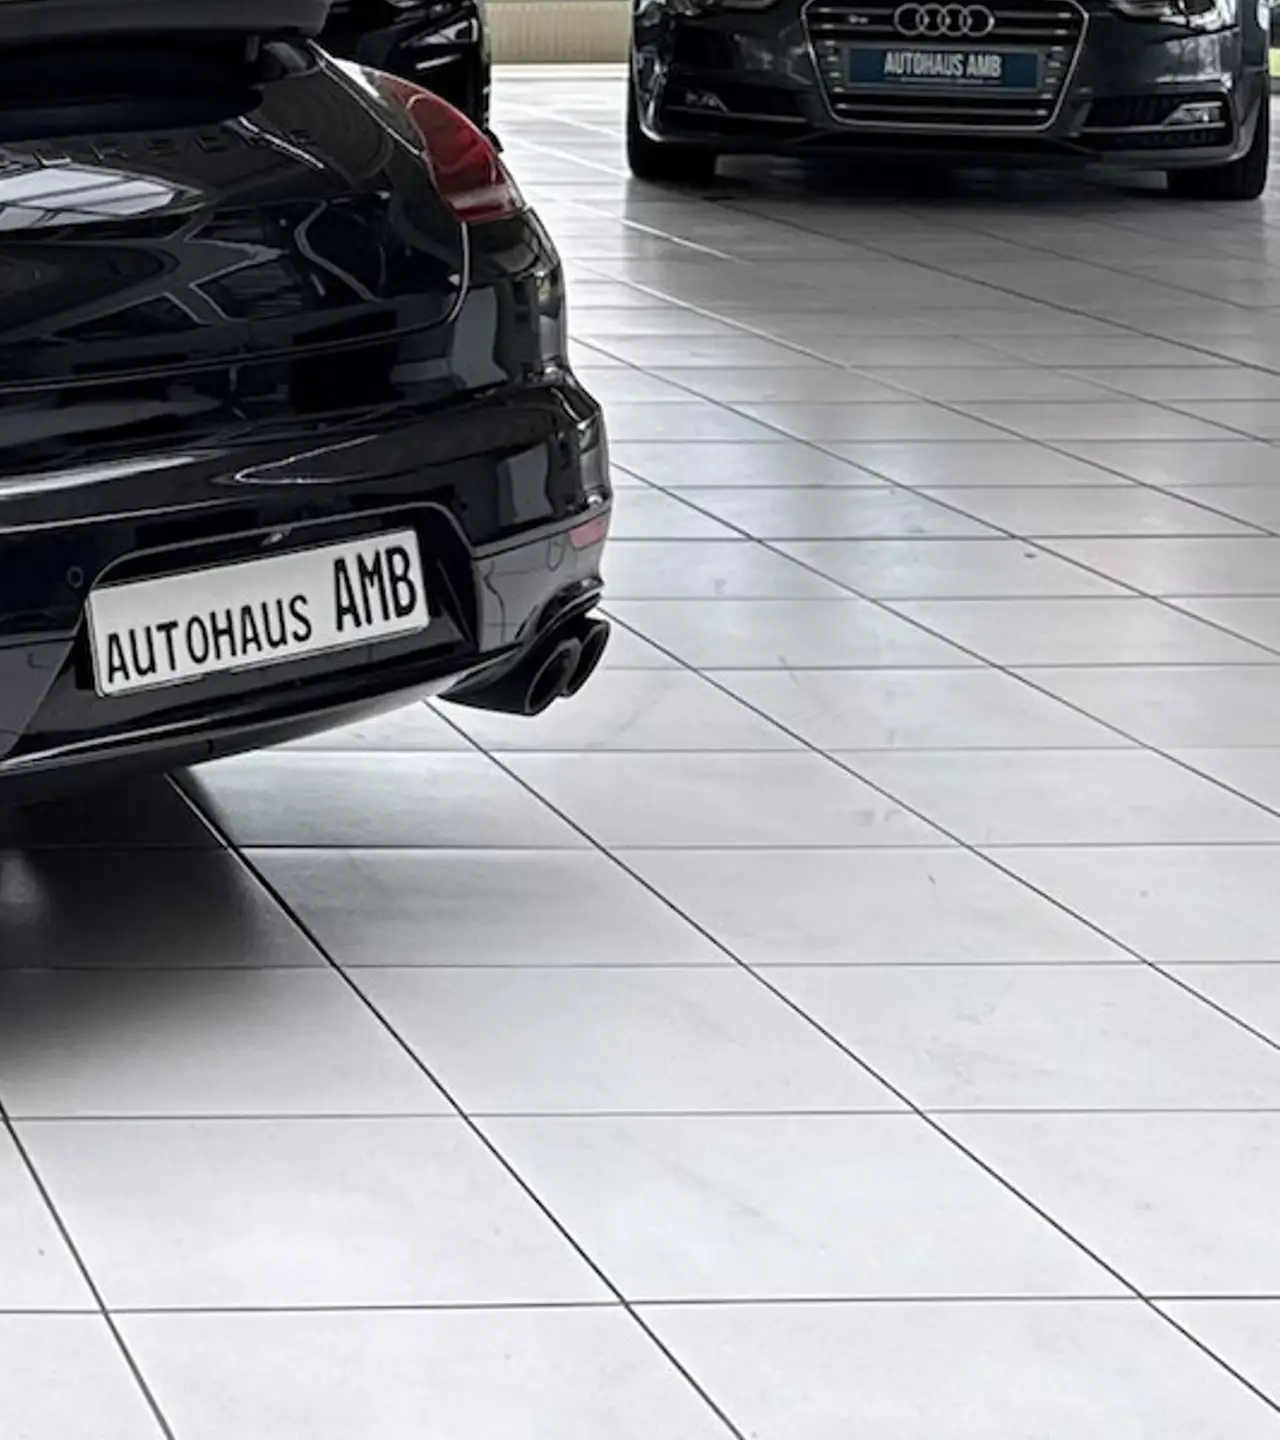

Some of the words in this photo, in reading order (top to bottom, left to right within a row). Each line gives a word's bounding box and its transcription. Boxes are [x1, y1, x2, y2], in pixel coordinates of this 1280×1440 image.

[883, 51, 964, 77] AUTOHAUS
[966, 54, 1002, 77] AMB
[107, 594, 313, 684] AUTOHAUS
[333, 544, 417, 633] AMB
